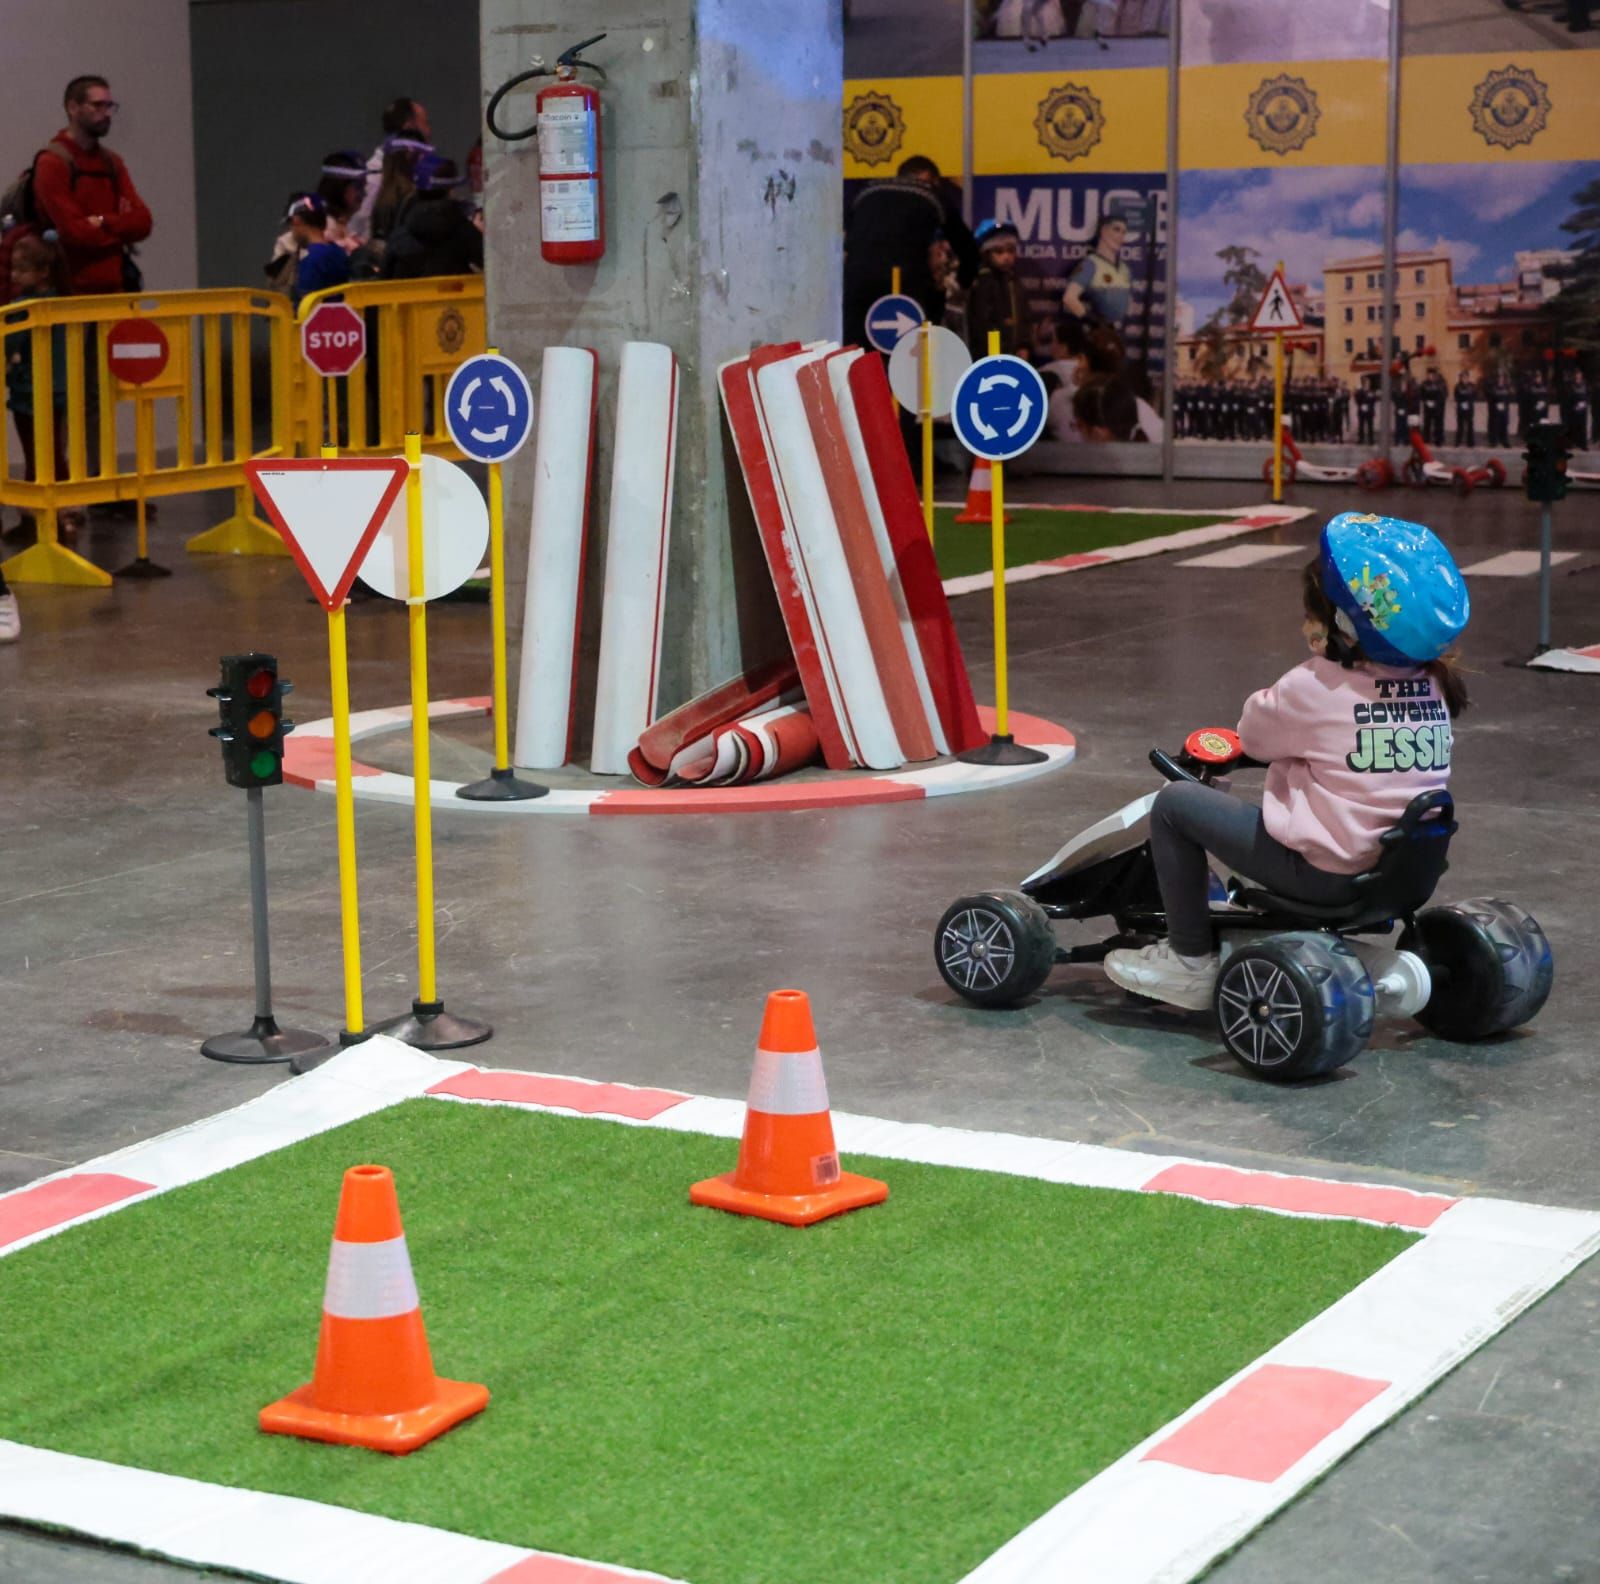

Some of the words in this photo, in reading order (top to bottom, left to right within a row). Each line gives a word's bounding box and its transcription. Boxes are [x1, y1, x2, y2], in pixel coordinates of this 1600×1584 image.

[309, 331, 359, 349] STOP
[1375, 679, 1430, 698] THE
[1354, 700, 1447, 724] COWGIRL
[1346, 724, 1451, 773] JESSIE
